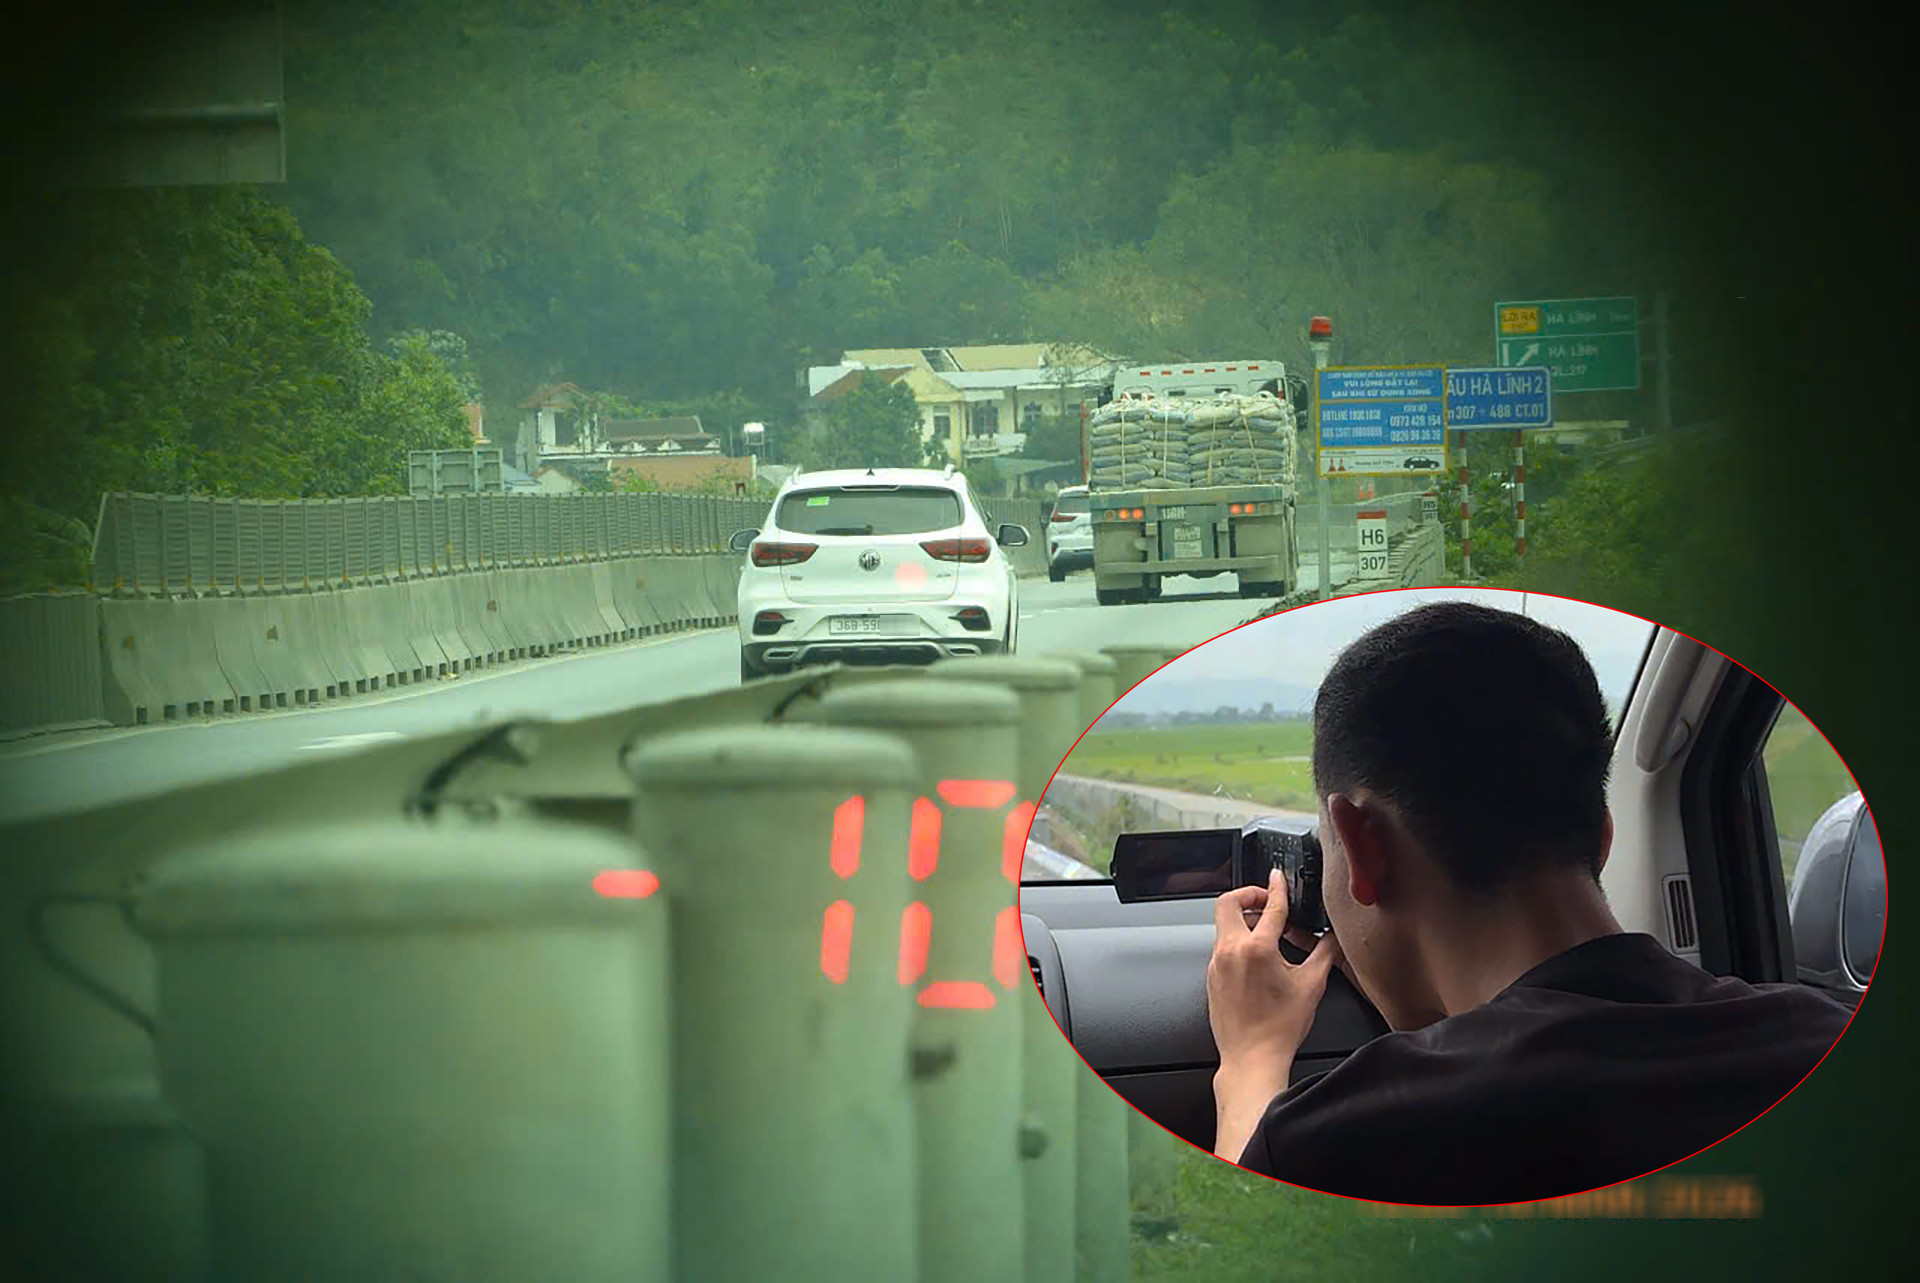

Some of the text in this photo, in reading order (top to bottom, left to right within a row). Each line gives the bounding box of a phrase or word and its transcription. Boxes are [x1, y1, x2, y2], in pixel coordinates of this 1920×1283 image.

[1471, 373, 1493, 396] HÀ
[1497, 372, 1532, 395] LĨNH
[1535, 375, 1544, 394] 2
[1361, 528, 1385, 546] H6
[1361, 556, 1386, 571] 307
